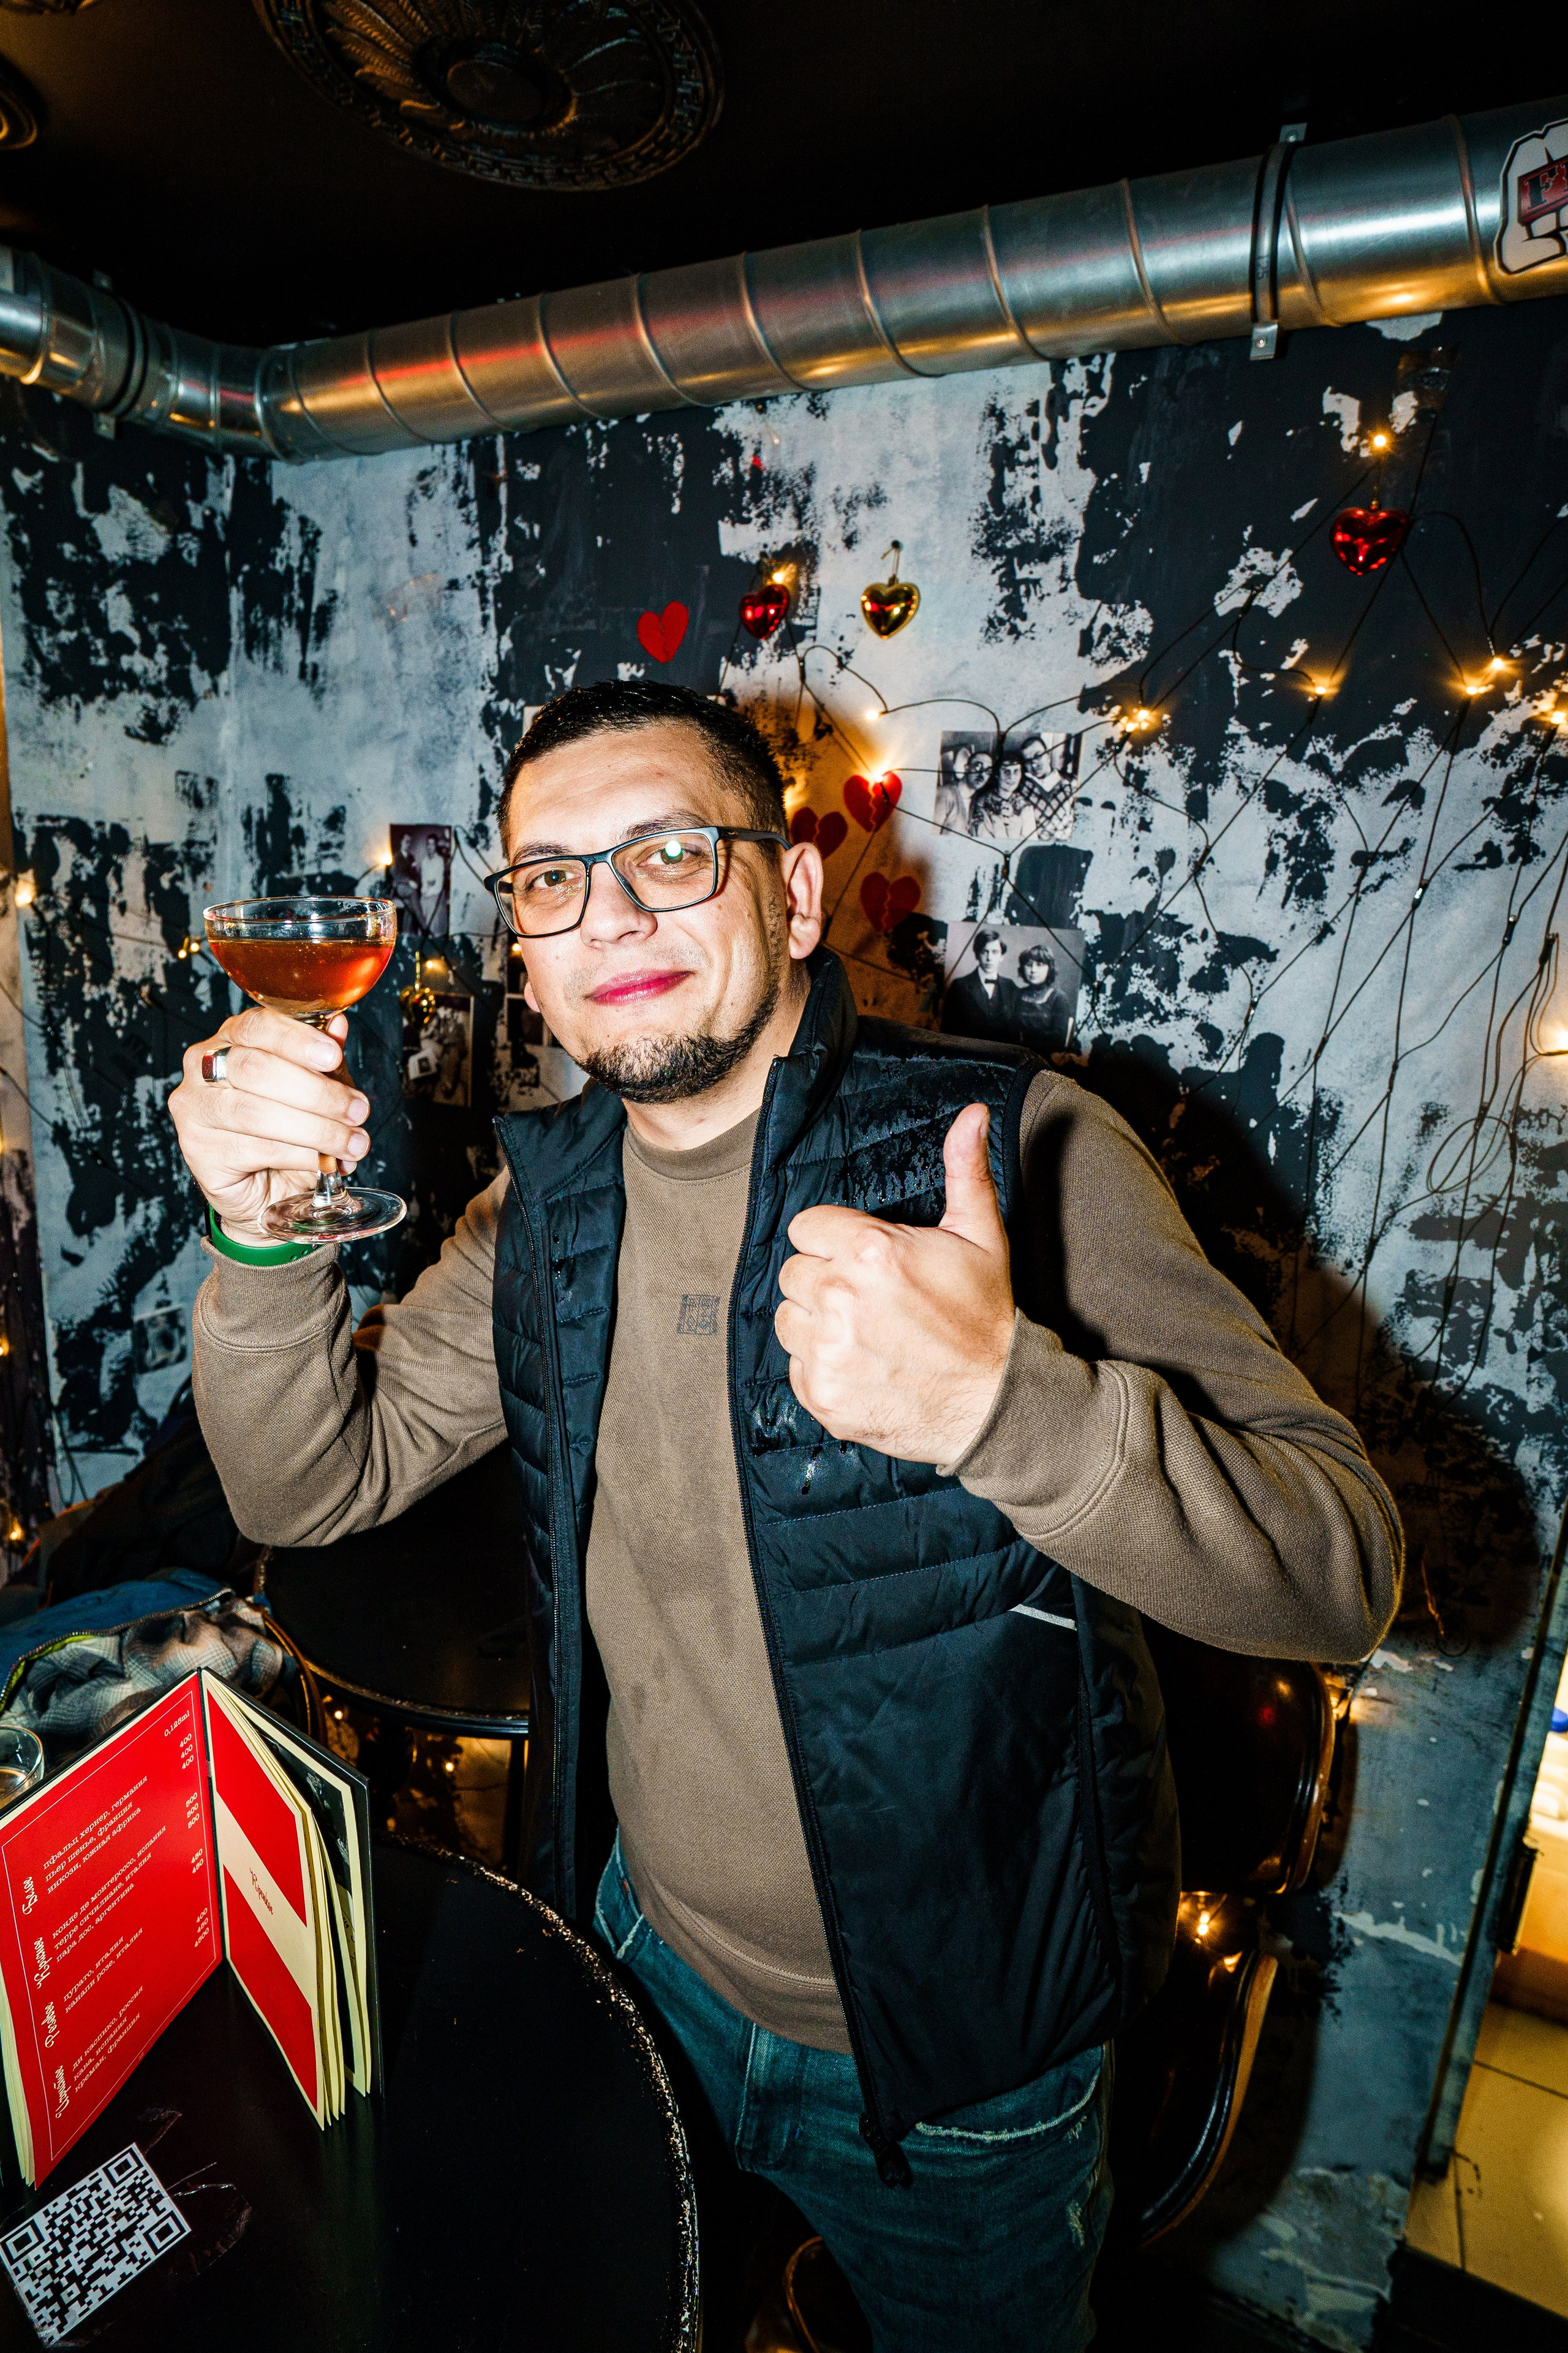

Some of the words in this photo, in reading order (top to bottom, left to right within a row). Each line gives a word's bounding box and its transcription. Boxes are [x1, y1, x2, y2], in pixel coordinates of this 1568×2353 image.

[1525, 161, 1568, 210] F
[179, 1733, 192, 1748] 400
[181, 1744, 194, 1759] 400
[181, 1755, 195, 1770] 400
[43, 1837, 78, 1870] пфальц
[80, 1811, 111, 1839] хернер,
[111, 1775, 148, 1811] германия
[186, 1792, 198, 1808] 500
[187, 1802, 199, 1818] 500
[187, 1813, 200, 1829] 500
[45, 1860, 67, 1882] пьер
[97, 1801, 133, 1837] франция
[48, 1864, 82, 1894] инкози,
[82, 1834, 111, 1864] южная
[111, 1807, 141, 1837] африка
[21, 1875, 38, 1915] Белое
[52, 1912, 79, 1939] конде
[80, 1901, 89, 1915] де
[91, 1857, 137, 1903] монтероссо,
[137, 1824, 167, 1858] испания
[55, 1924, 79, 1951] терре
[125, 1851, 152, 1882] италия
[56, 1939, 77, 1963] пара
[95, 1883, 134, 1925] аргентина
[196, 1907, 208, 1923] 400
[34, 1936, 52, 1989] Красное
[65, 1978, 96, 2014] канапи
[116, 1926, 143, 1960] италия
[95, 1935, 124, 1969] италия
[41, 2001, 60, 2048] Розовое
[72, 2055, 83, 2072] ди
[119, 1985, 143, 2018] россия
[96, 2015, 127, 2057] испания
[107, 2012, 140, 2055] франция
[53, 2065, 72, 2119] Игристое
